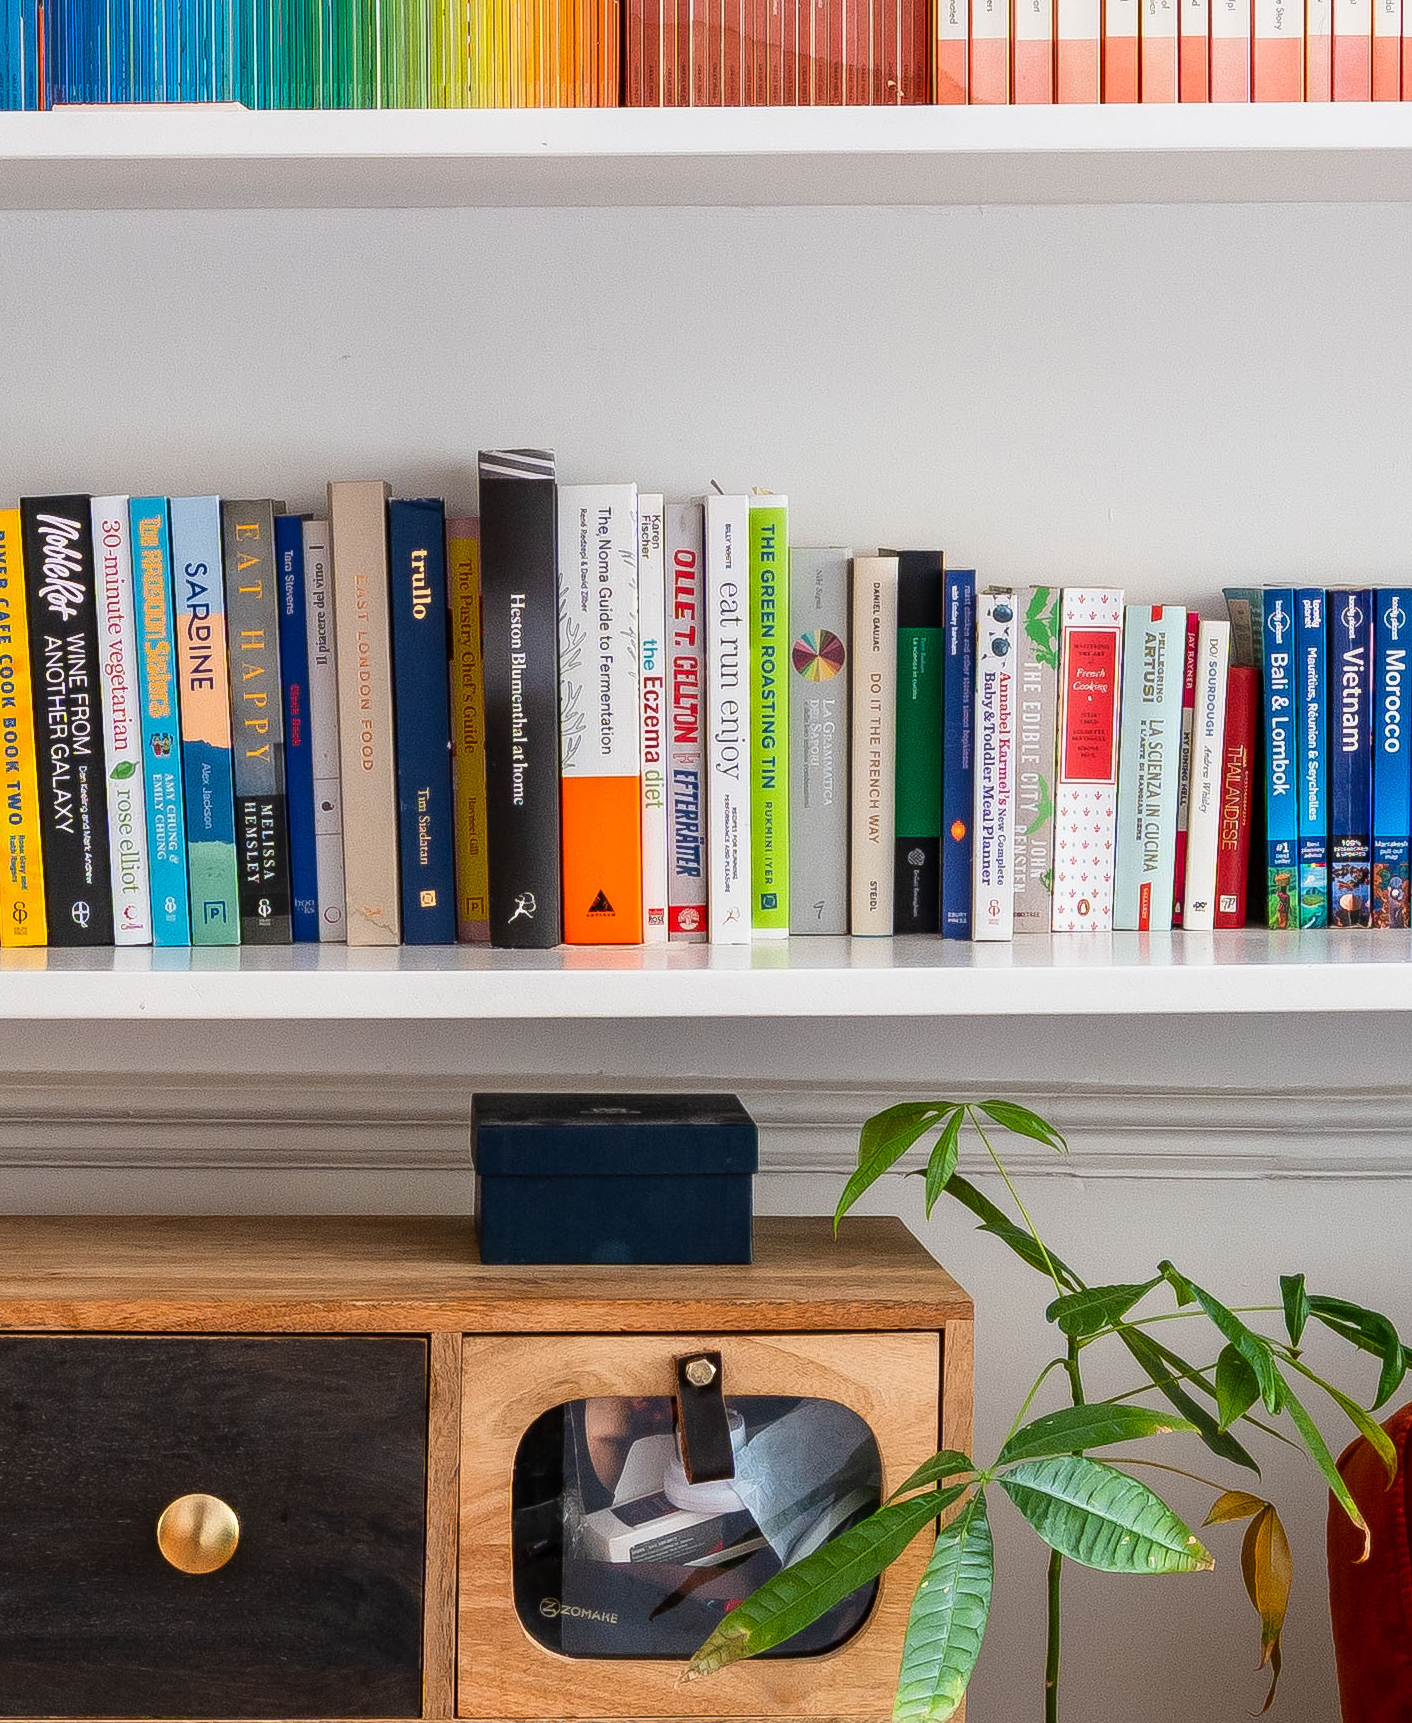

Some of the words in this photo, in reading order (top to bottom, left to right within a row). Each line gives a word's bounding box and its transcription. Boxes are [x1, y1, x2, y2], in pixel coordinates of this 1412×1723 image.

[100, 519, 127, 635] 30-minute
[235, 523, 263, 600] EAT
[761, 524, 775, 562] THE
[410, 549, 431, 620] trullo
[719, 582, 740, 627] eat
[761, 569, 775, 638] GREEN
[185, 563, 213, 691] SARDINE
[510, 594, 525, 649] Heston
[643, 639, 660, 670] the
[44, 636, 68, 740] ANOTHER
[67, 633, 87, 689] WINE
[105, 639, 133, 752] vegetarian
[719, 637, 741, 690] run
[761, 645, 776, 748] ROASTING
[1271, 653, 1287, 689] Bali
[69, 696, 89, 755] FROM
[239, 630, 271, 764] HAPPY
[512, 653, 527, 743] Blumenthal
[644, 676, 662, 763] Eczema
[1205, 661, 1218, 737] SOURDOUGH
[1273, 695, 1287, 711] &
[1341, 647, 1363, 752] Vietnam
[1384, 649, 1405, 753] Morocco
[512, 746, 525, 761] at
[715, 700, 742, 780] enjoy
[761, 756, 776, 789] TIN
[1272, 717, 1289, 795] Lombok
[50, 744, 73, 833] GALAXY
[512, 763, 527, 805] home
[645, 769, 664, 808] diet
[561, 1605, 618, 1624] ZOMAKE
